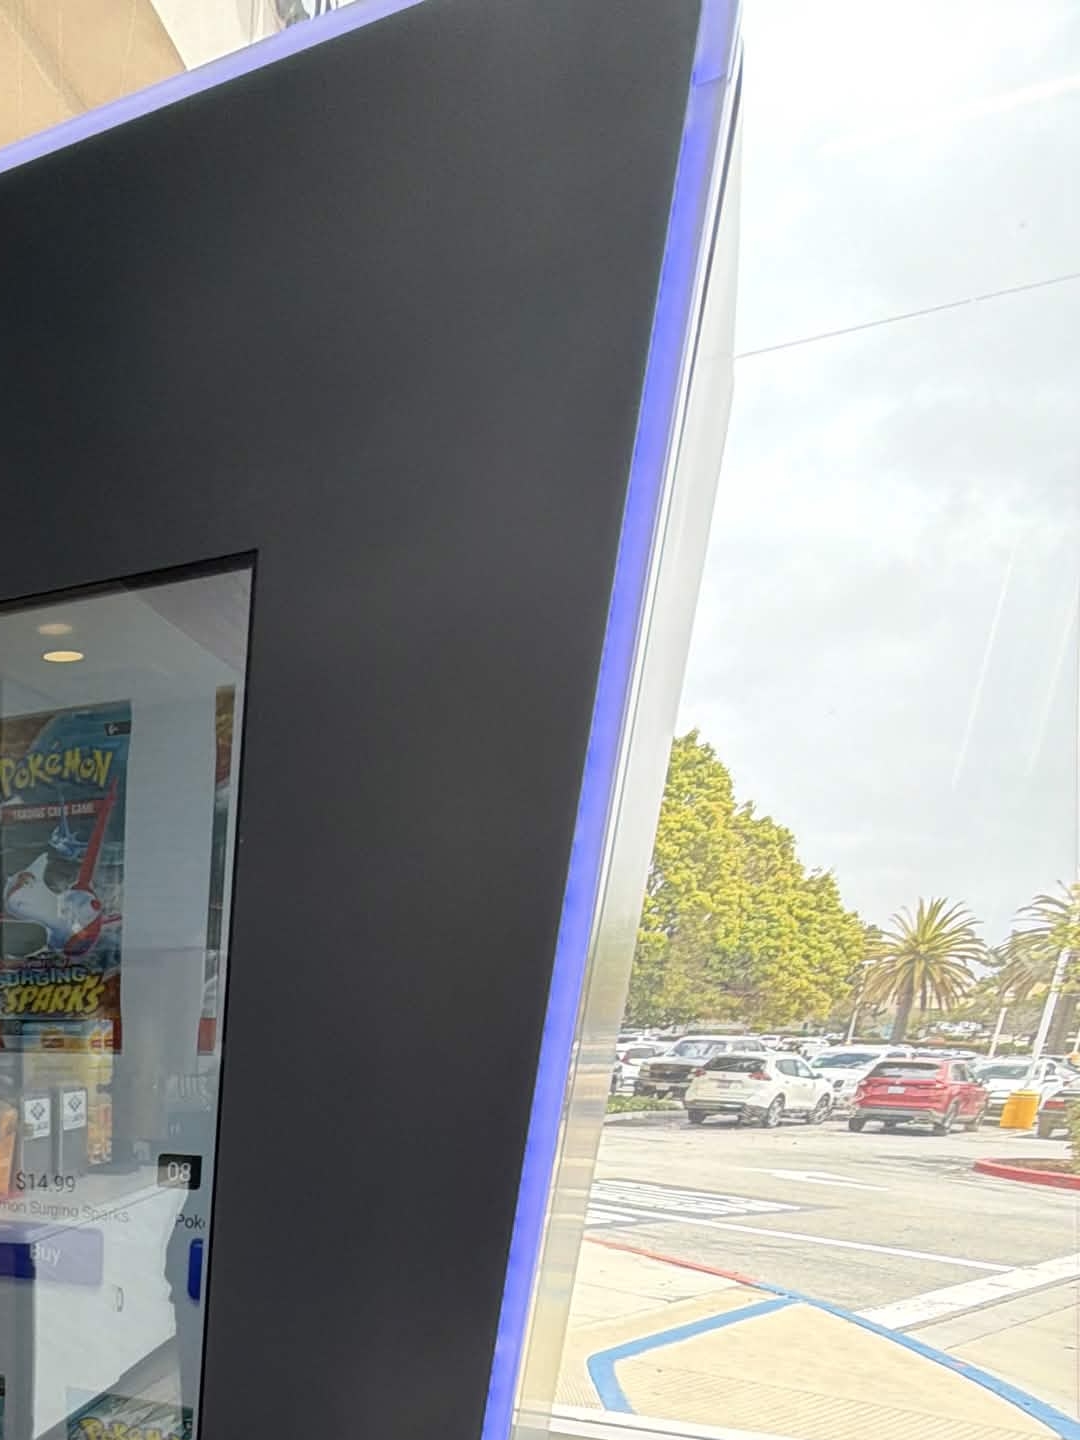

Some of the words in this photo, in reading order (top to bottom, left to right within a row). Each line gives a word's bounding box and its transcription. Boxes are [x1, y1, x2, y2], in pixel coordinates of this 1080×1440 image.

[4, 975, 105, 1014] SPARKS
[16, 1172, 77, 1193] $14.99
[167, 1161, 192, 1182] 08
[30, 1242, 62, 1266] Buy
